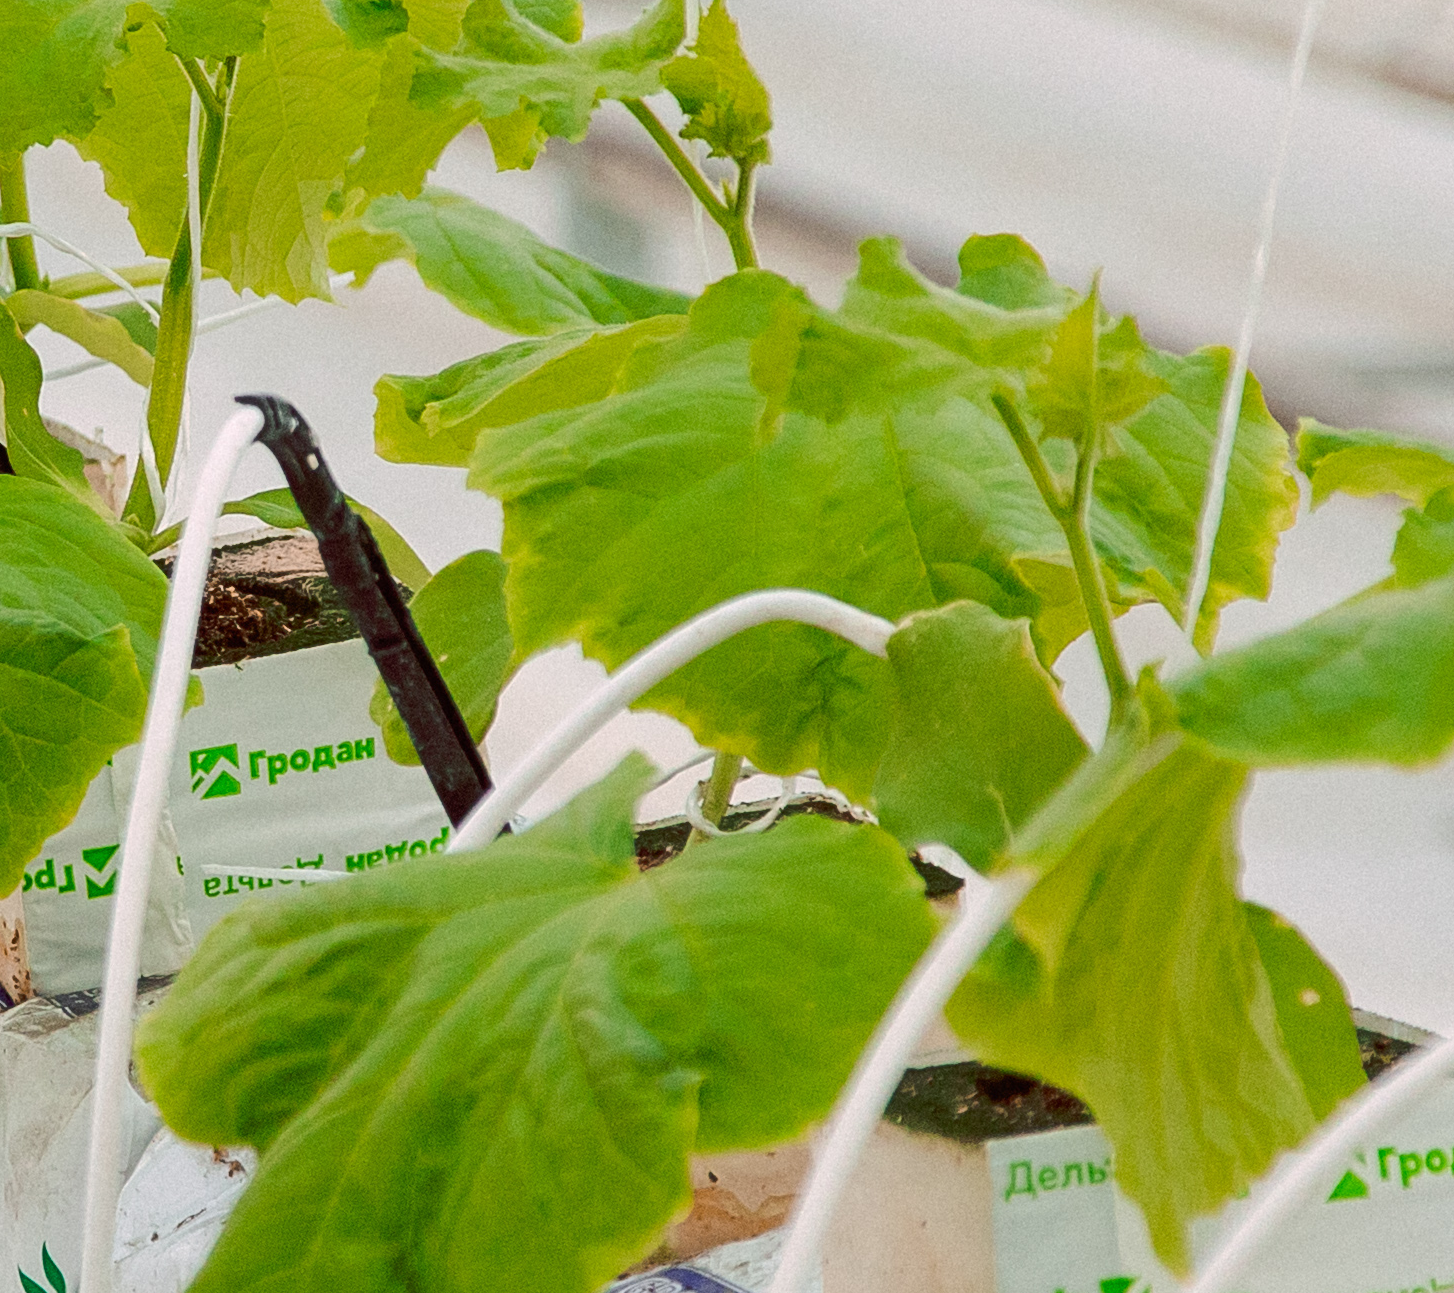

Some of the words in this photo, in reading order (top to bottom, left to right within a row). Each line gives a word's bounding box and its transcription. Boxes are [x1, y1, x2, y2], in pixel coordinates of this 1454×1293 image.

[248, 737, 376, 786] Гродан
[345, 826, 449, 873] родан
[1004, 1157, 1112, 1202] Дель
